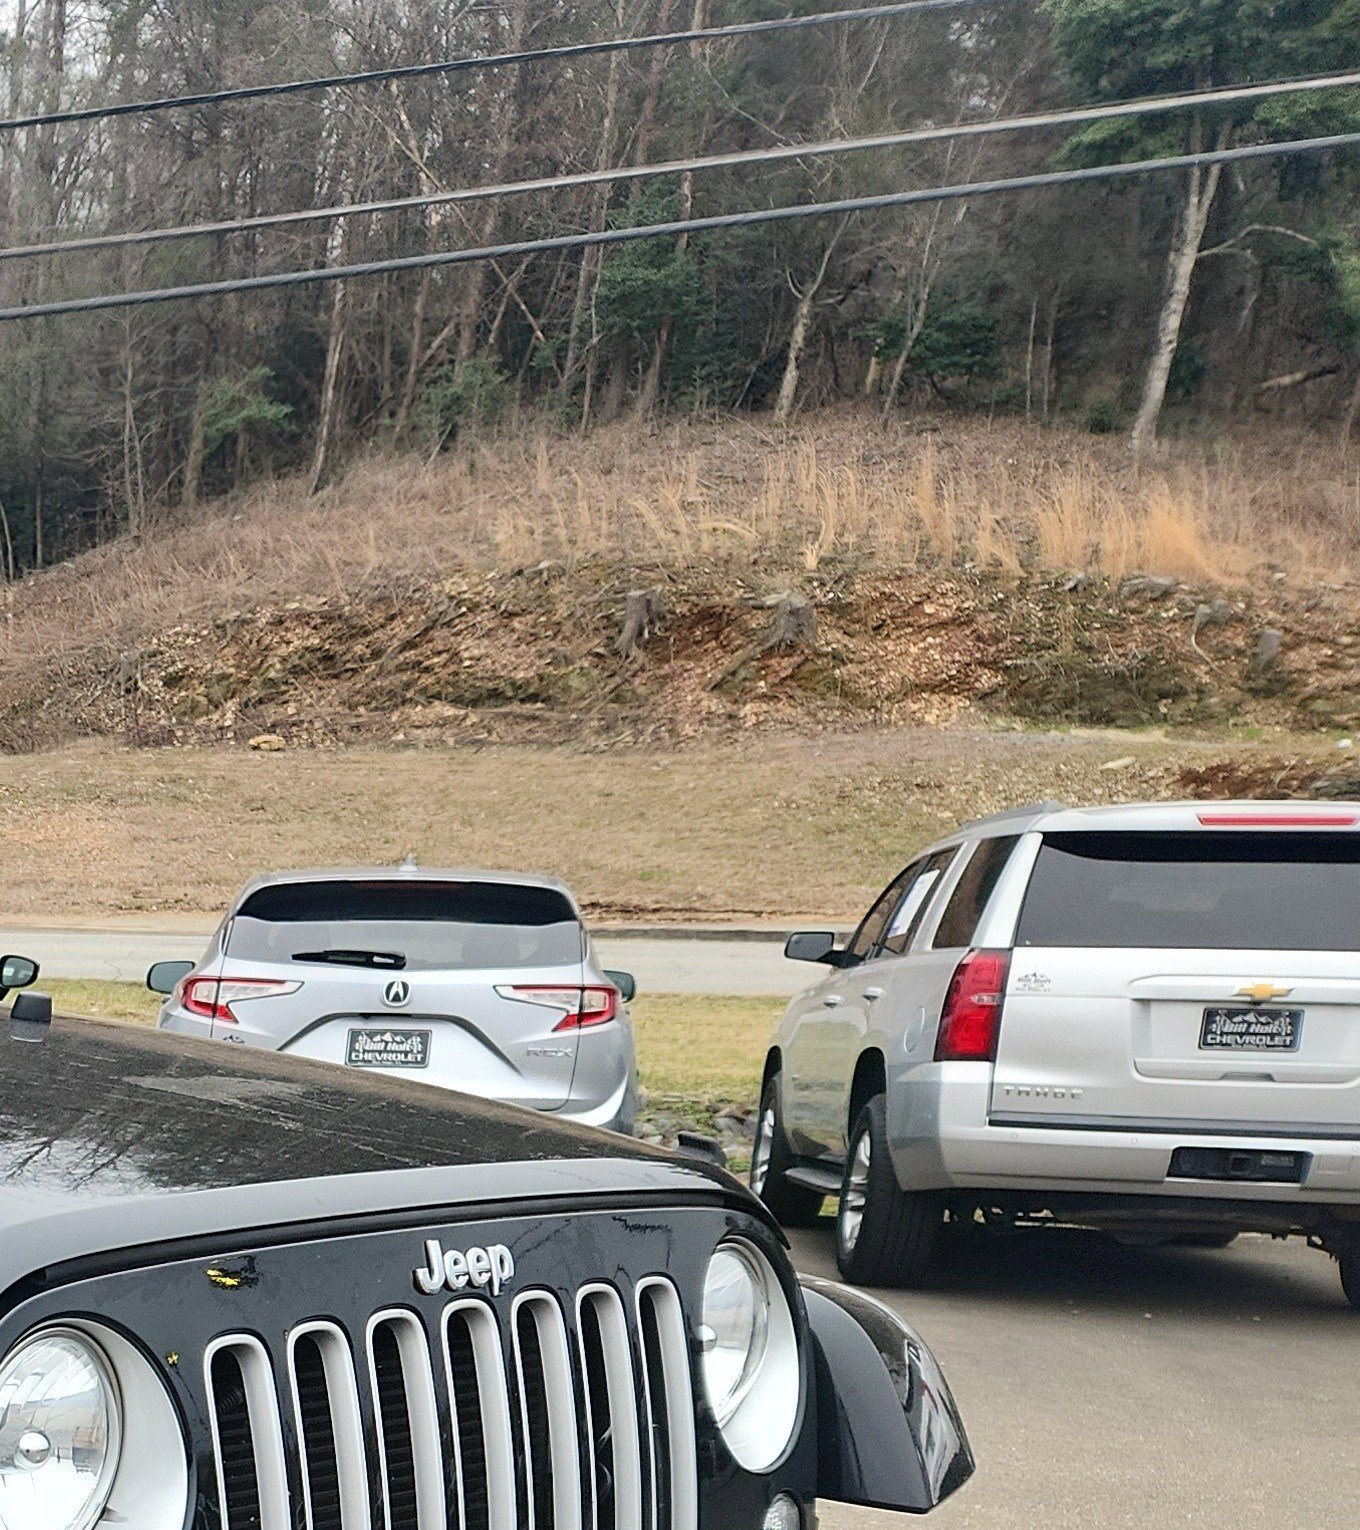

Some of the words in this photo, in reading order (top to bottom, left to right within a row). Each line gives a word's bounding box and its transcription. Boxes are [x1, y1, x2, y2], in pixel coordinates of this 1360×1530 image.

[1206, 1034, 1294, 1046] CHEVROLET
[351, 1051, 424, 1062] CHEVROLET
[526, 1047, 573, 1058] RDX
[1003, 1085, 1083, 1100] TAHOE
[412, 1239, 514, 1297] Jeep
